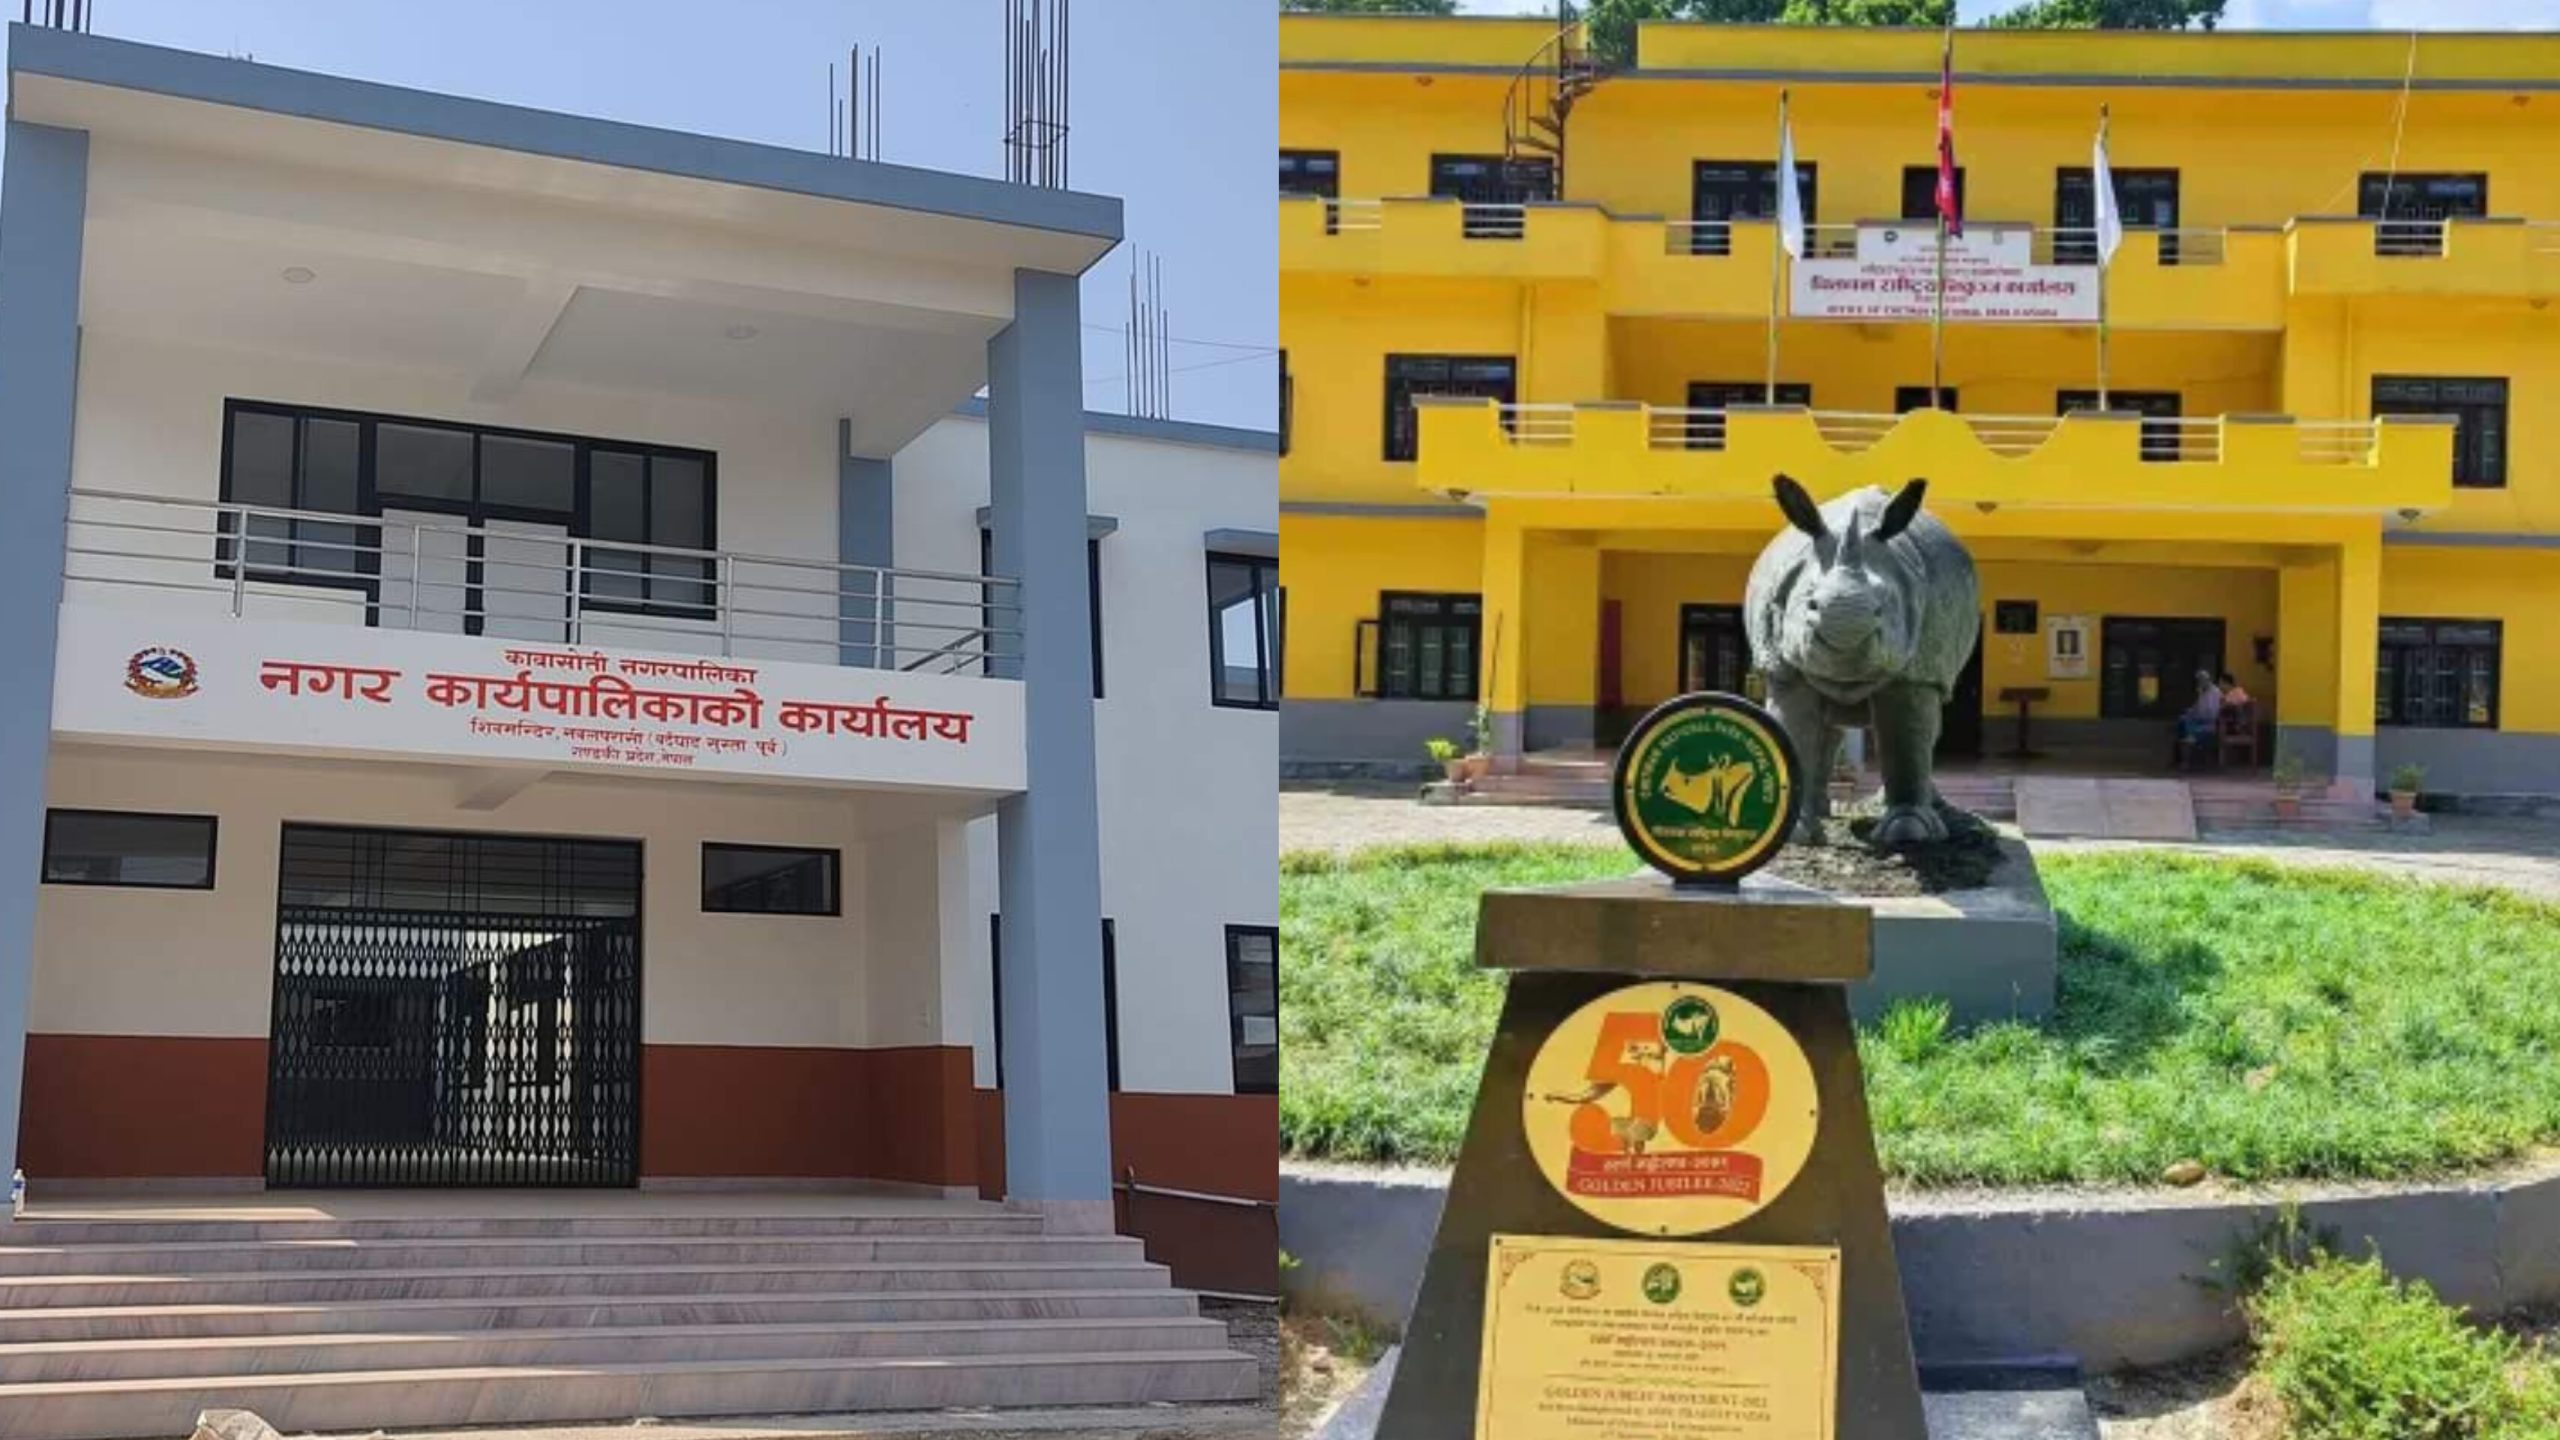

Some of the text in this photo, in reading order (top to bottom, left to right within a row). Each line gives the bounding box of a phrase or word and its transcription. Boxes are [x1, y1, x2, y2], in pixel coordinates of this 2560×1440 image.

[619, 659, 757, 685] नगरपालिका
[261, 661, 974, 743] नगर कार्यपालिकाको कार्यालय
[1570, 1012, 1770, 1154] 50
[1578, 1177, 1645, 1192] GOLDEN
